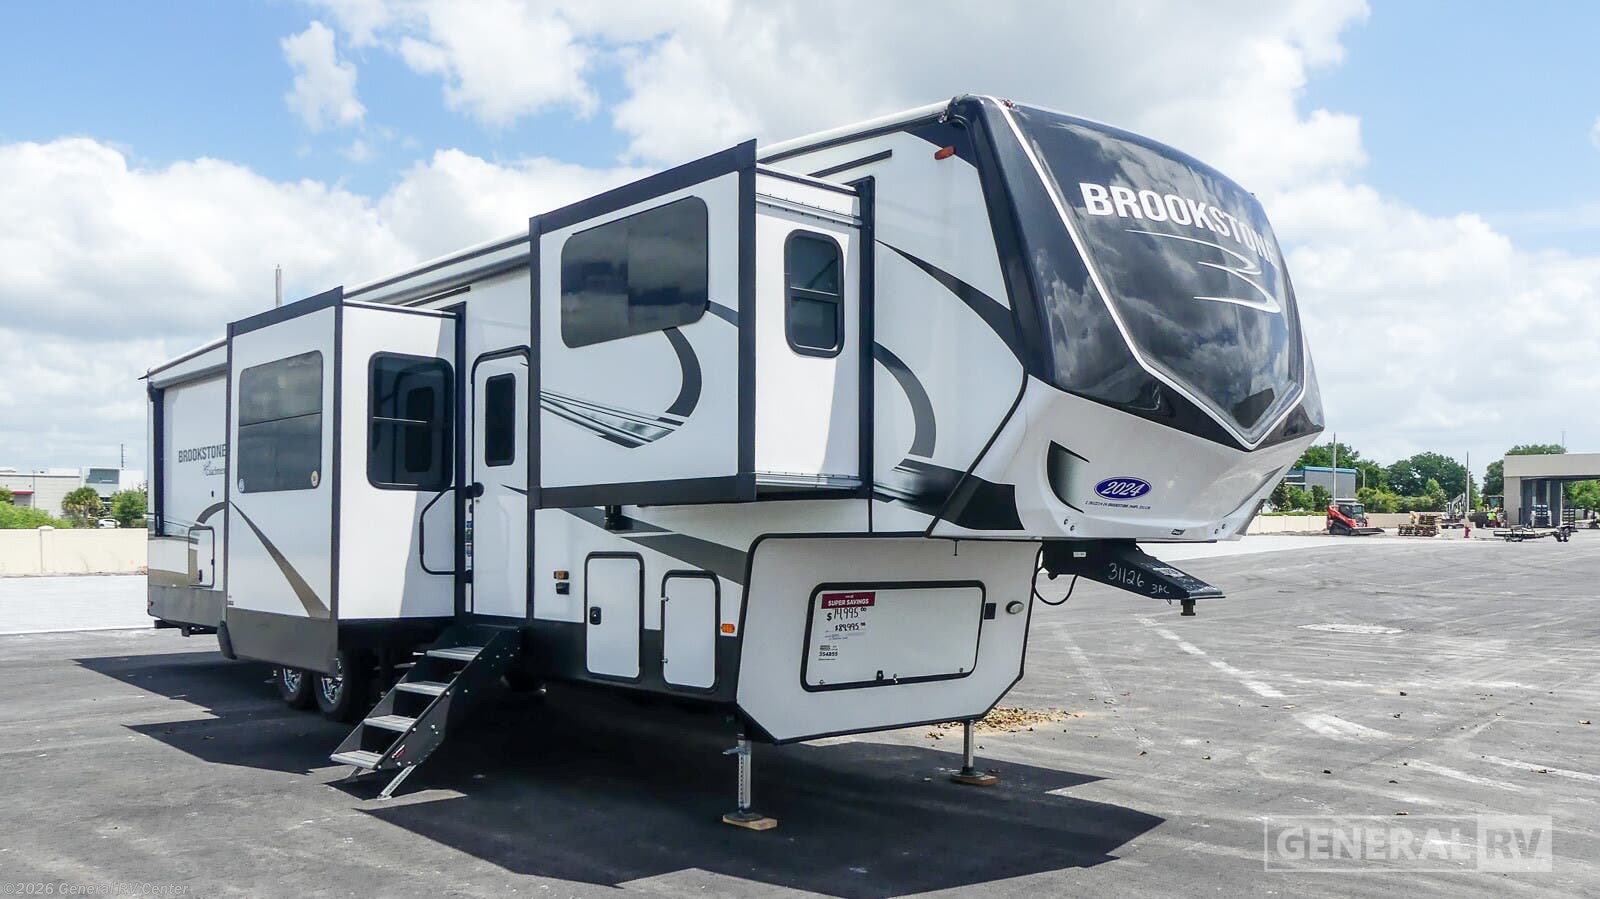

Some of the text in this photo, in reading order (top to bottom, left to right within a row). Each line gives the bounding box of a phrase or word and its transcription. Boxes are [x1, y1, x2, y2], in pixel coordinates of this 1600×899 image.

[1079, 182, 1277, 266] BROOKSTONE
[178, 444, 226, 463] BROOKSTONE
[1101, 481, 1144, 497] 2024
[1107, 562, 1145, 586] 31126
[846, 598, 869, 606] SAVINGS
